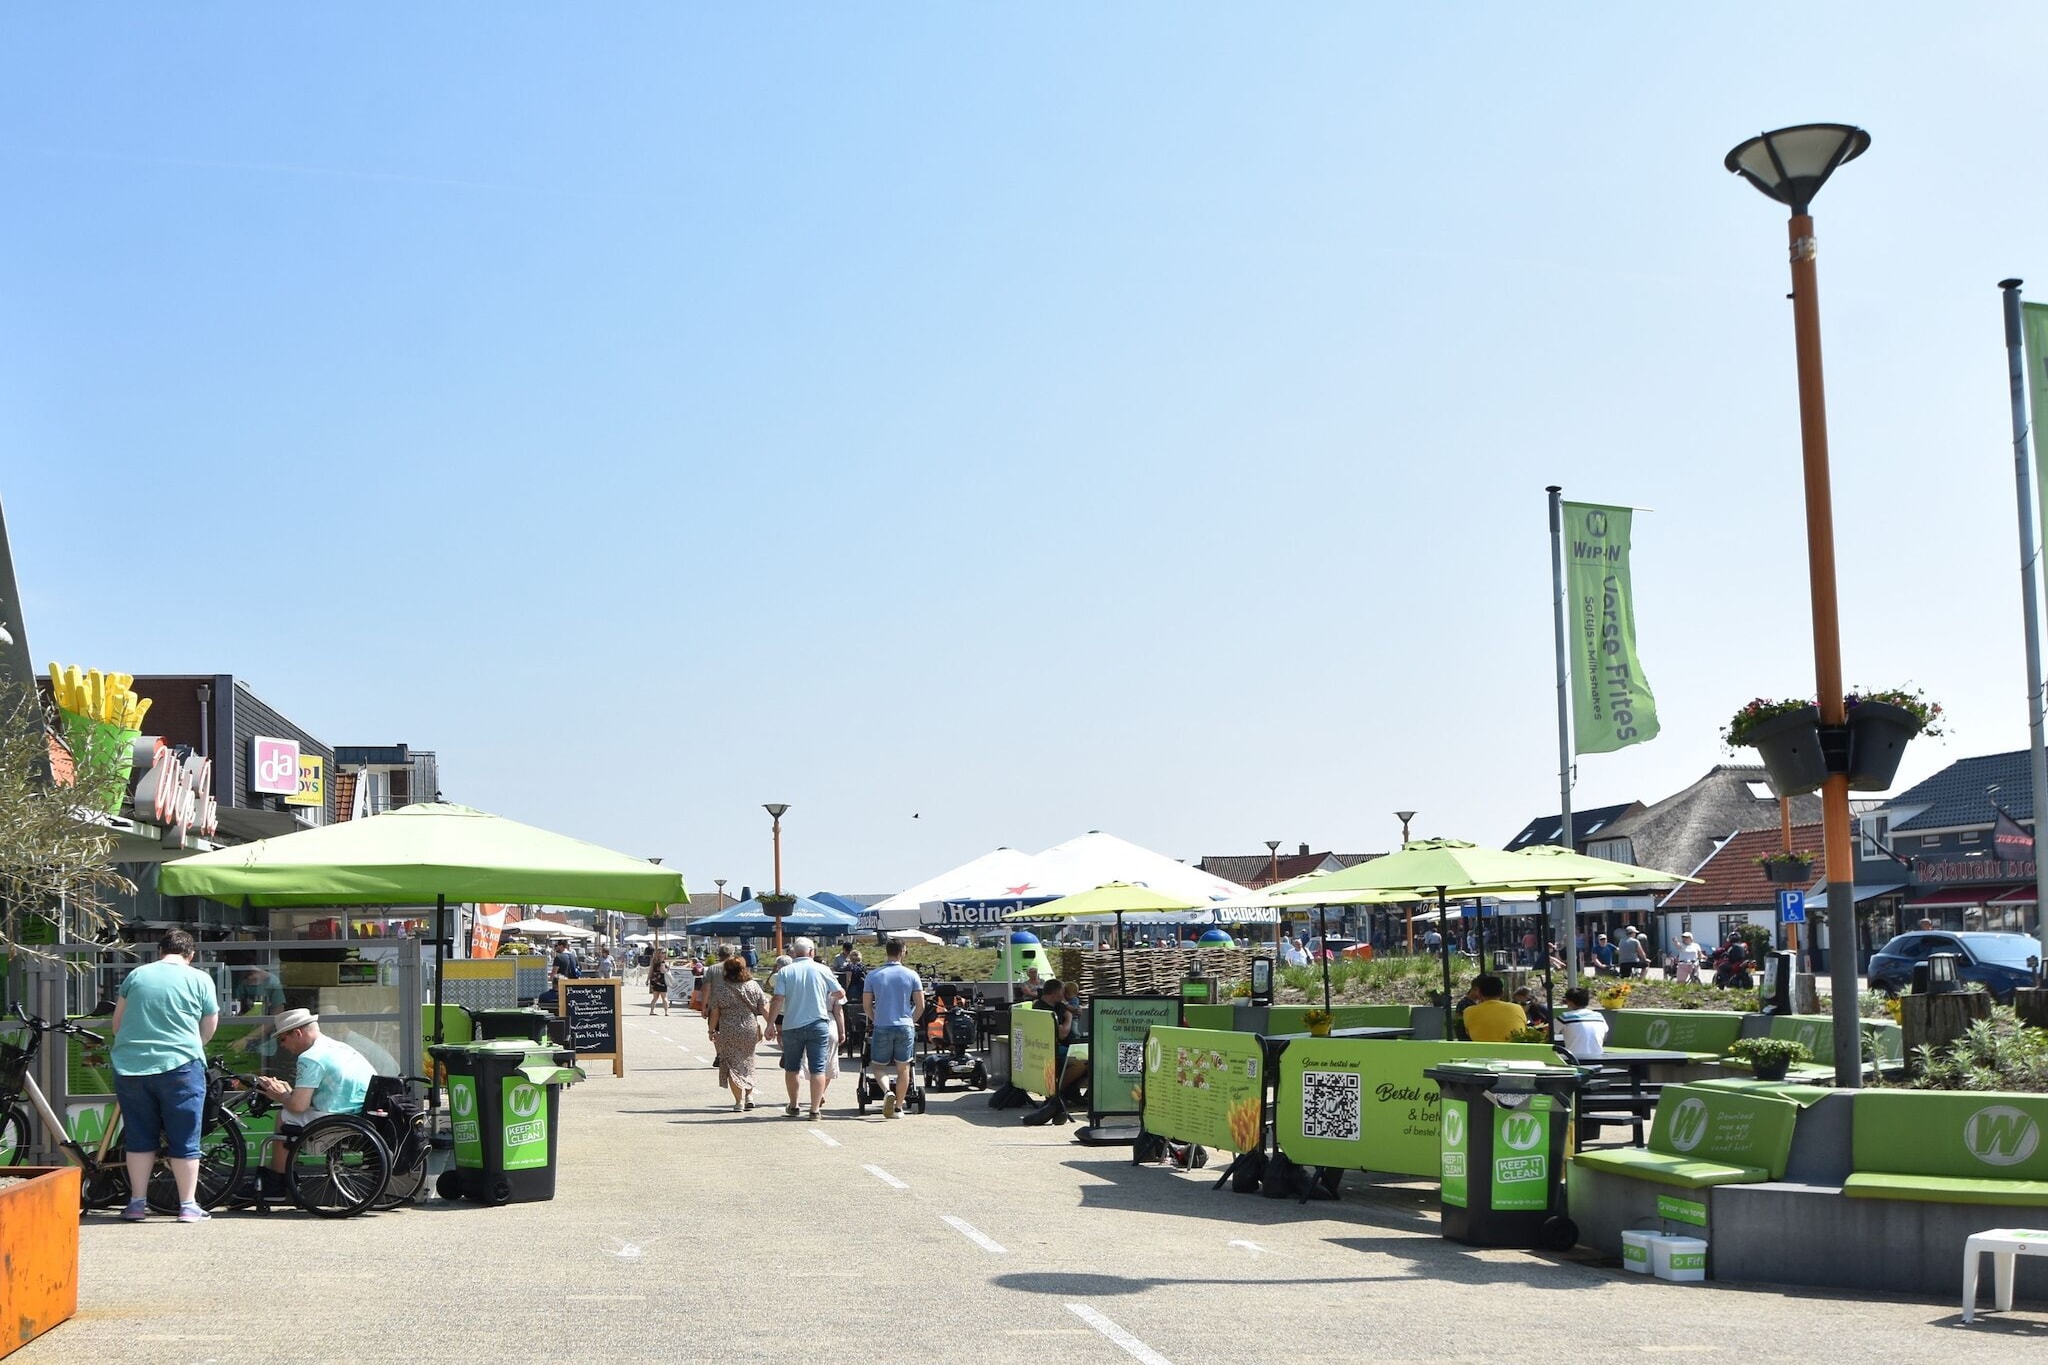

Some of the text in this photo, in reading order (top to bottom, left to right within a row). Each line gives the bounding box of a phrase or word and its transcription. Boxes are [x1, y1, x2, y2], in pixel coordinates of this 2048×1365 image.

[1584, 596, 1602, 721] Softijs Milkshakes
[1605, 663, 1637, 741] Frites
[260, 749, 293, 783] da
[298, 780, 319, 792] OYS
[1918, 858, 2003, 881] Restaurant
[1786, 893, 1799, 910] P
[1376, 1083, 1421, 1102] Bestel
[1408, 1107, 1441, 1122] & bet
[508, 1122, 541, 1135] KEEP IT
[1403, 1125, 1412, 1135] of
[1413, 1125, 1437, 1137] bestel
[510, 1131, 540, 1144] CLEAN
[1500, 1159, 1540, 1171] KEEP IT
[1502, 1169, 1539, 1180] CLEAN
